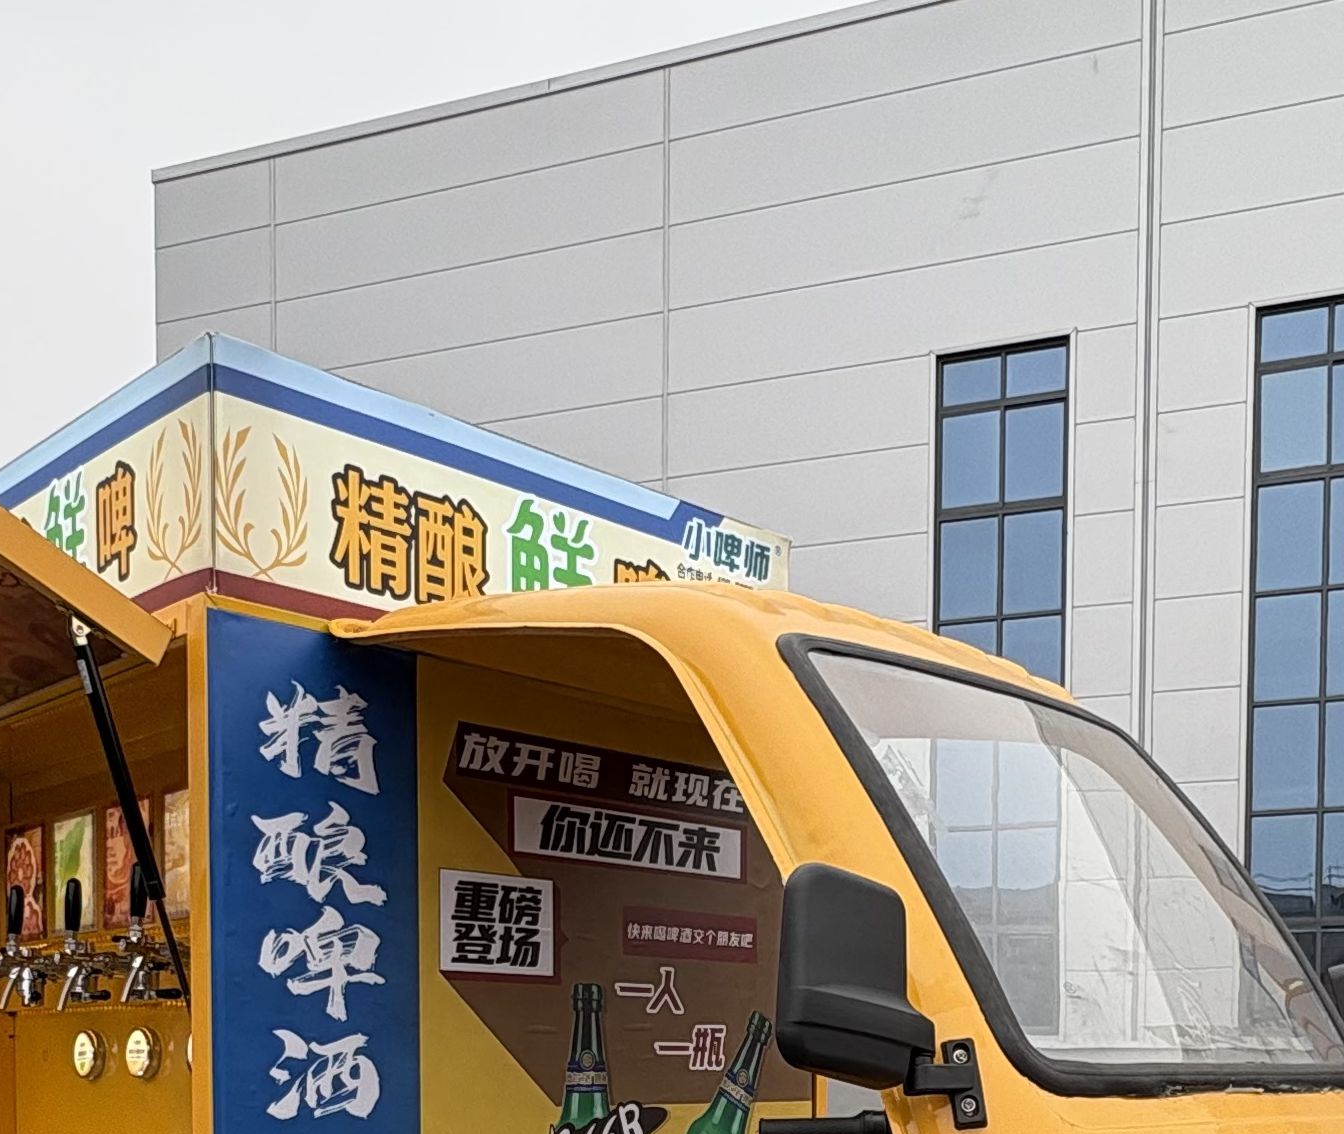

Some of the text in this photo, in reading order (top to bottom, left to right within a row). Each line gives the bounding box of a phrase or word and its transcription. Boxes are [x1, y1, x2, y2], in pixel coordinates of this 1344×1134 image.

[22, 461, 137, 582] 鲜啤
[682, 518, 772, 582] 小啤师
[458, 732, 744, 814] 放开喝 就现在
[539, 804, 721, 872] 你还不来
[251, 680, 388, 1120] 精酿啤酒
[451, 880, 543, 926] 重磅
[451, 922, 541, 968] 登场
[614, 967, 685, 1014] 一人
[654, 1025, 727, 1071] 一瓶
